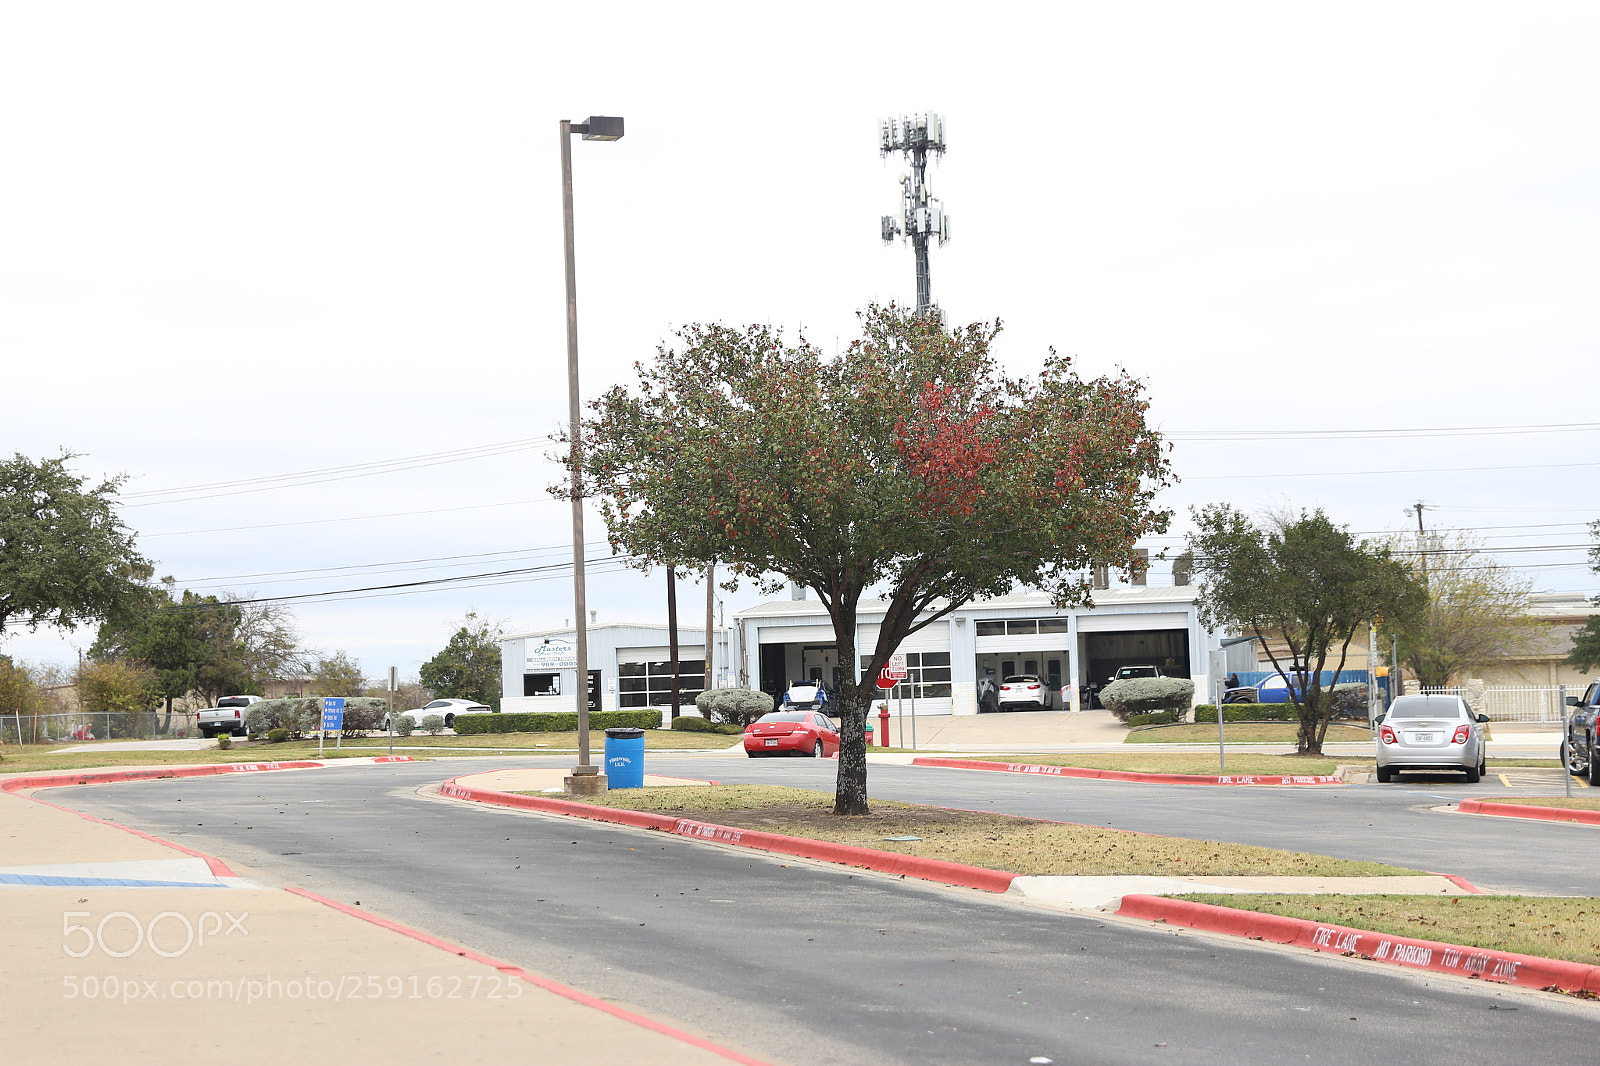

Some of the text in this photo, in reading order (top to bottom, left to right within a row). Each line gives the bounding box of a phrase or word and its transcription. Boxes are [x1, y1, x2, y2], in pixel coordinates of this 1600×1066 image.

[534, 645, 572, 653] Masters
[1218, 776, 1255, 784] FIRE LANE
[1312, 927, 1523, 980] FIRE LANE NO PARKING TOW AWAY ZONE
